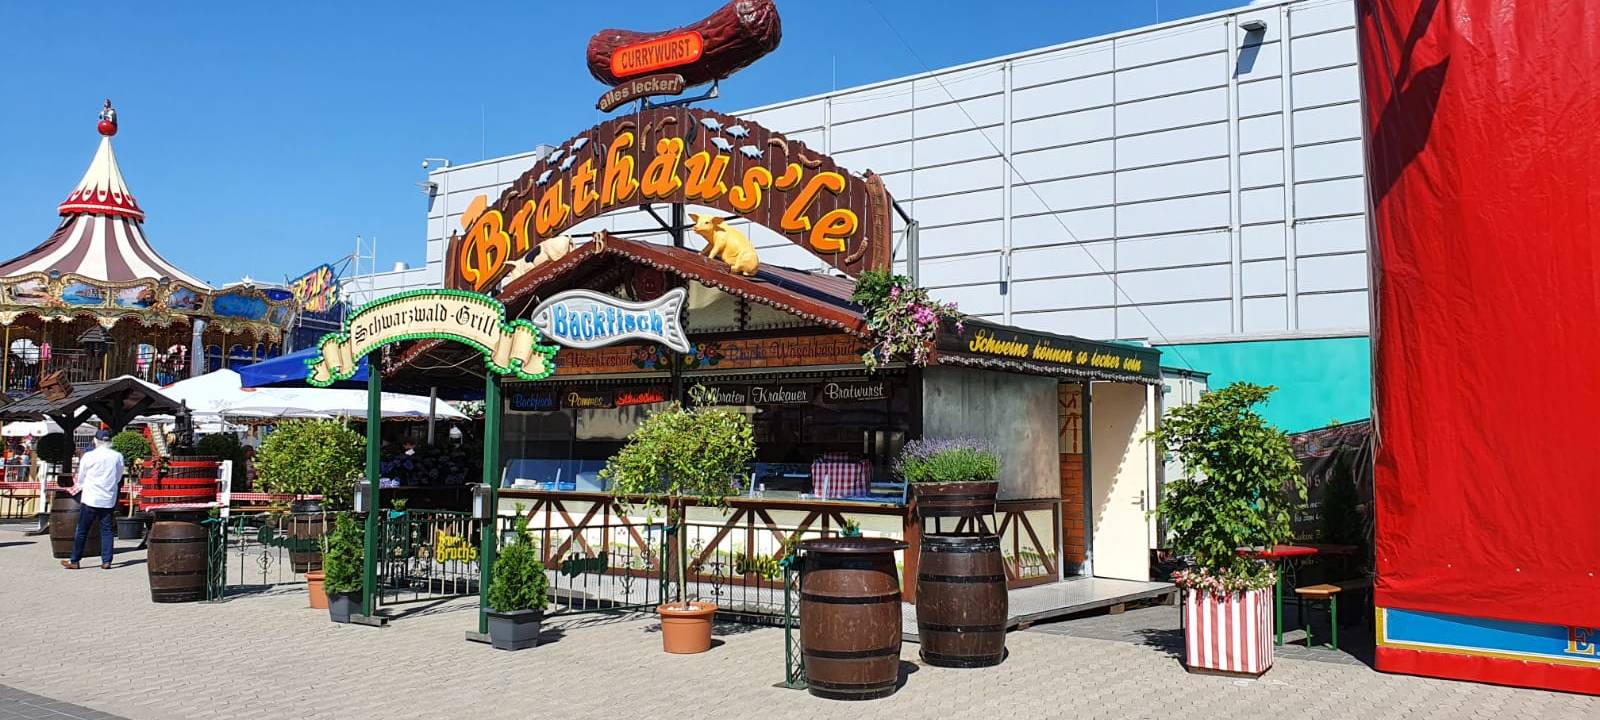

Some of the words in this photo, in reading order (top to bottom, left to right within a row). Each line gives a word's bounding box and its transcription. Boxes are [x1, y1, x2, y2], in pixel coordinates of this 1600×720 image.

[620, 38, 691, 70] CURRYWURST
[599, 87, 629, 110] alles
[631, 77, 679, 95] lecker!
[552, 302, 664, 340] Backfisch
[969, 329, 1029, 357] Schweine
[1032, 338, 1073, 364] können
[1075, 350, 1089, 366] so
[1091, 348, 1121, 370] lecker
[1122, 353, 1142, 373] sein
[568, 391, 603, 408] Pommes
[752, 386, 807, 403] Krakauer
[824, 382, 885, 400] Bratwurst
